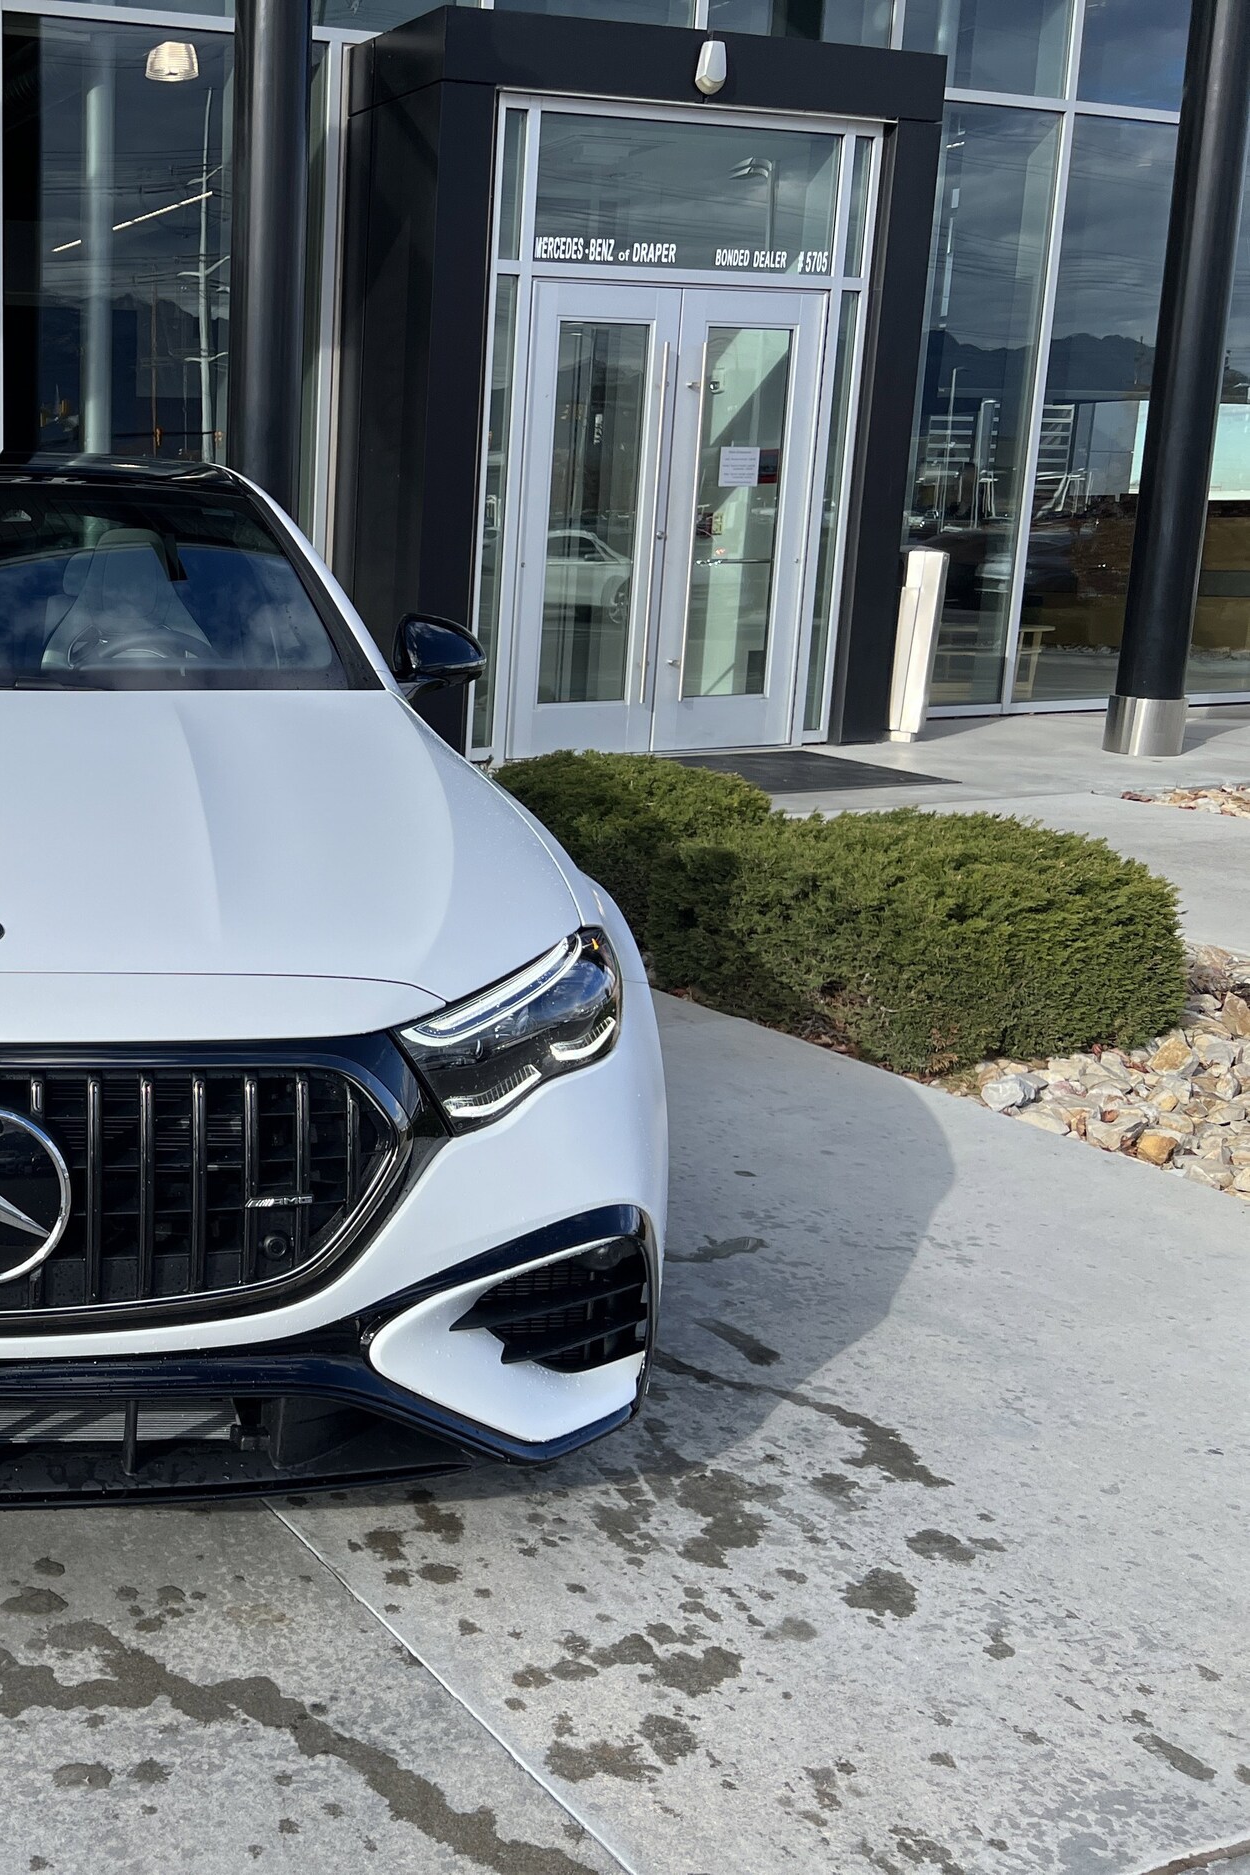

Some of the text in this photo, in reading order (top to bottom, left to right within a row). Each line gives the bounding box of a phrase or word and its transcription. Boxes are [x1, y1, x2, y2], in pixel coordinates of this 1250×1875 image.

[618, 249, 630, 261] of
[632, 242, 677, 263] DRAPER
[715, 248, 750, 267] BONDED
[752, 250, 788, 268] DEALER
